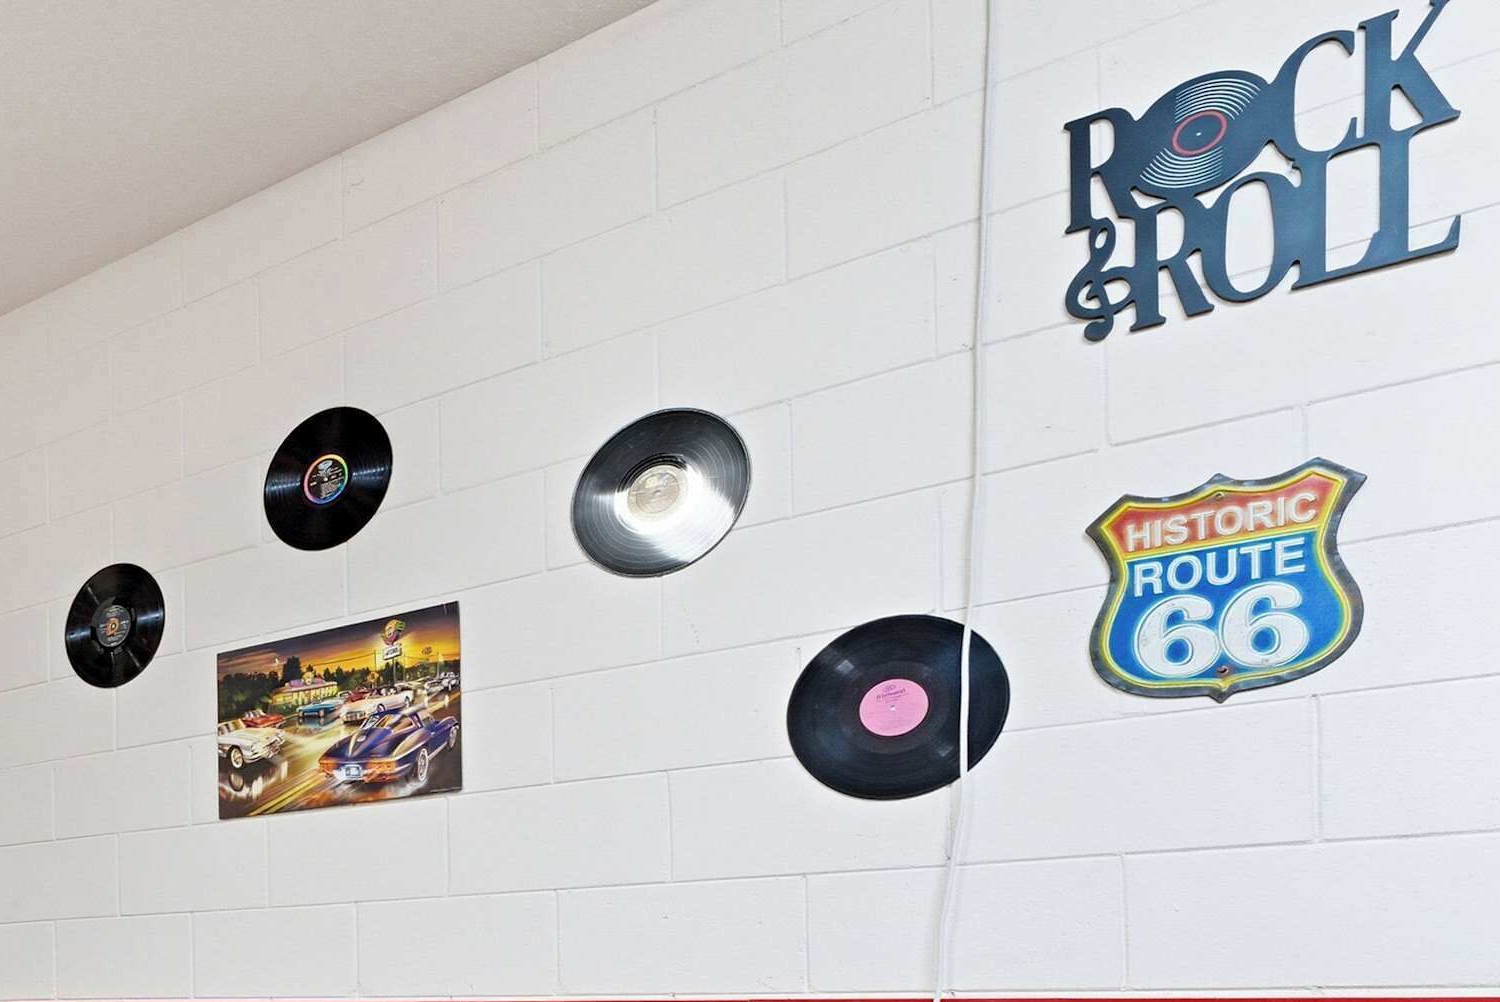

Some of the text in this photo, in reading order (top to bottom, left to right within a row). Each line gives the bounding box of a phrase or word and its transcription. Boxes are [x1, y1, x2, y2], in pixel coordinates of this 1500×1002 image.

[1064, 0, 1461, 234] ROCK
[1129, 137, 1462, 332] ROLL
[1125, 493, 1318, 552] HISTORIC
[1133, 537, 1306, 598] ROUTE
[1134, 581, 1310, 679] 66
